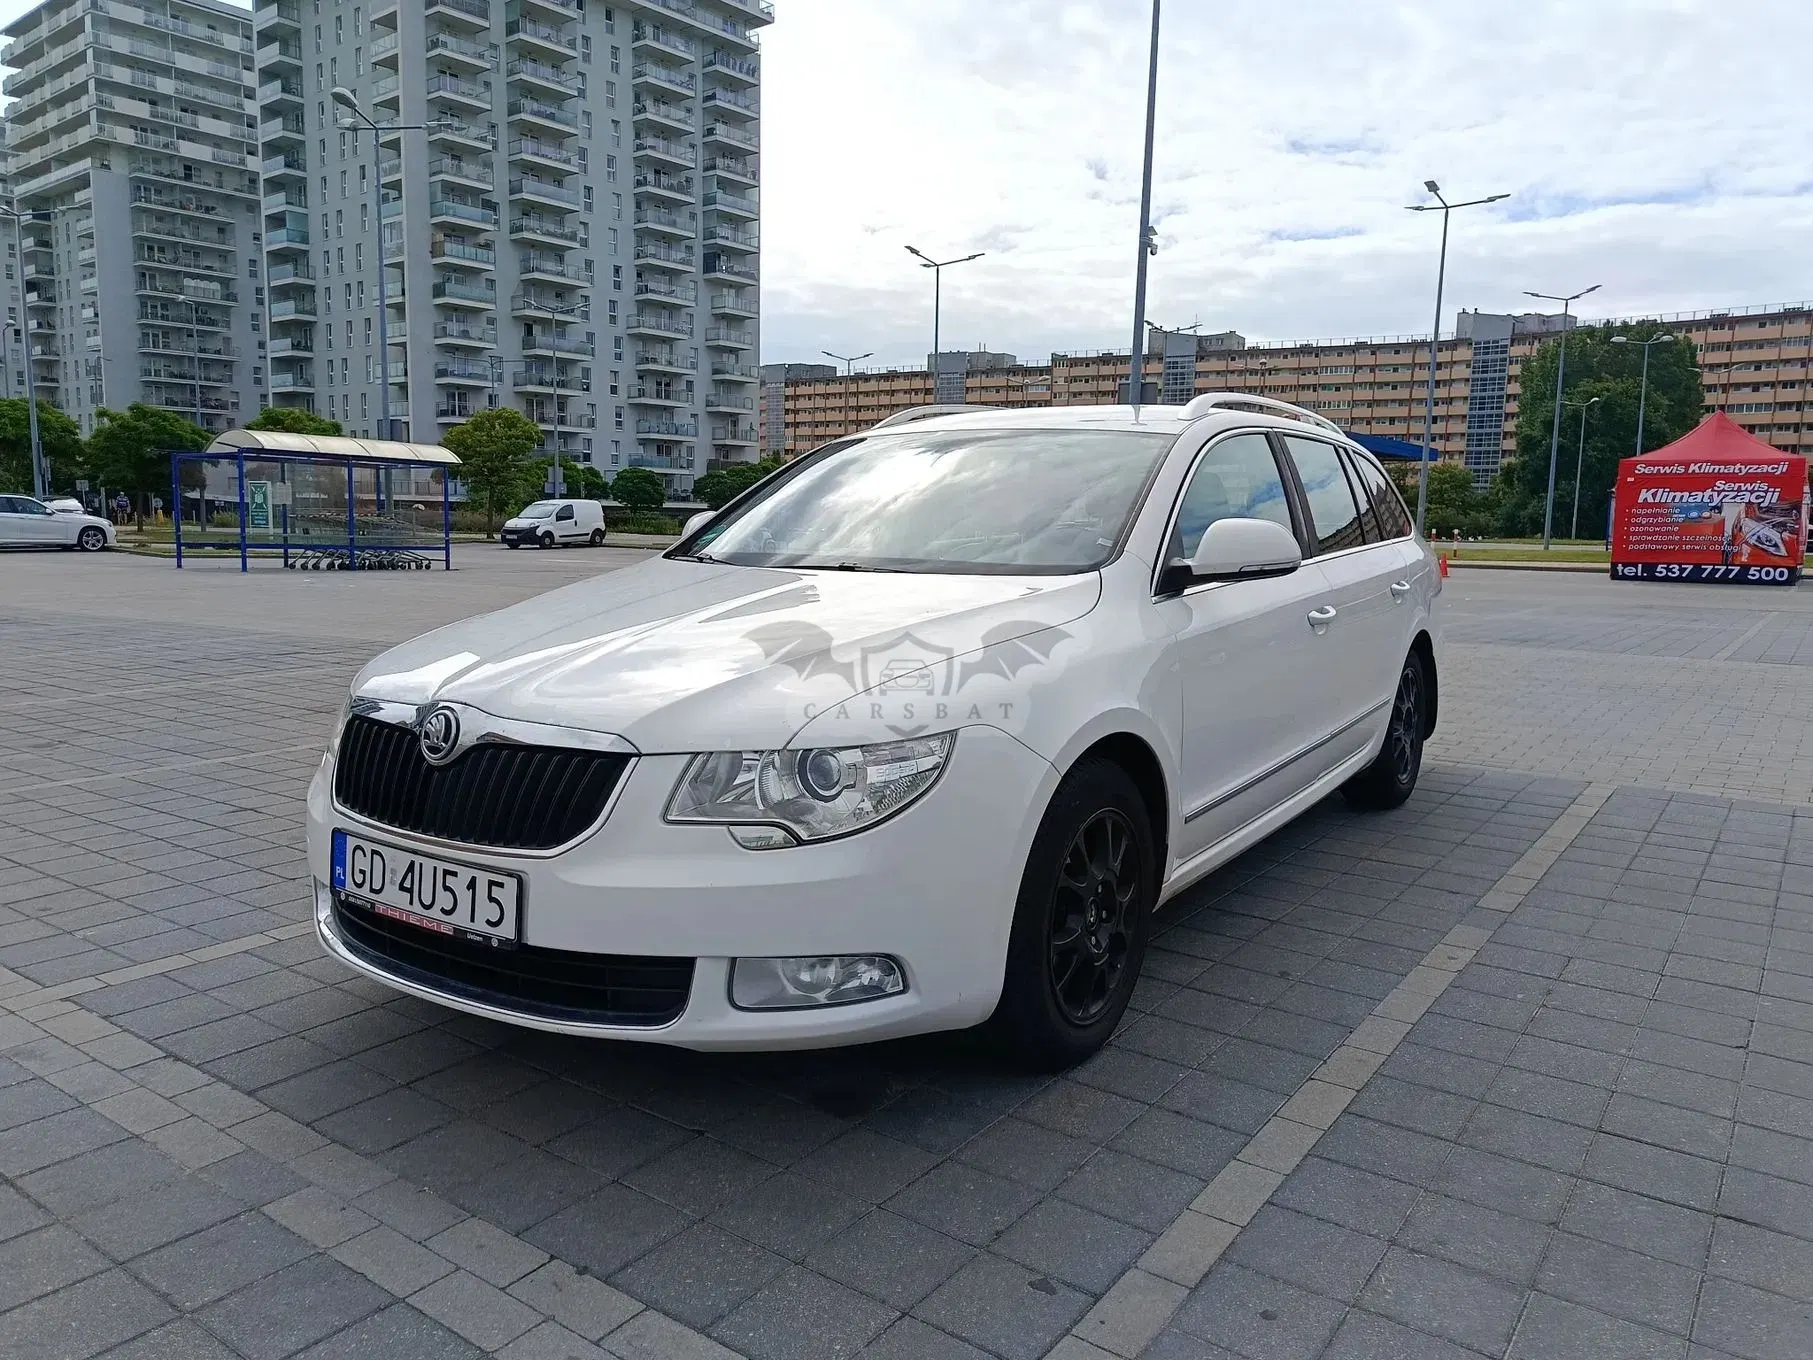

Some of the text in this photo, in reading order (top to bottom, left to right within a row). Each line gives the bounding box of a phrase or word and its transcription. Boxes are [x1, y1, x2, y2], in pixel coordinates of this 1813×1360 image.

[1635, 462, 1788, 475] Serwis Klimatyzacji
[1714, 480, 1769, 491] Serwis
[1638, 488, 1781, 506] Klimatyzacji
[1631, 516, 1684, 524] odgrzybianie
[1629, 534, 1680, 542] sprawdzanie
[1628, 543, 1680, 551] podstawowy
[1617, 563, 1789, 581] tel. 537 777 500
[335, 865, 345, 880] PL
[351, 844, 505, 928] GD 4U515
[375, 904, 454, 935] THIEME
